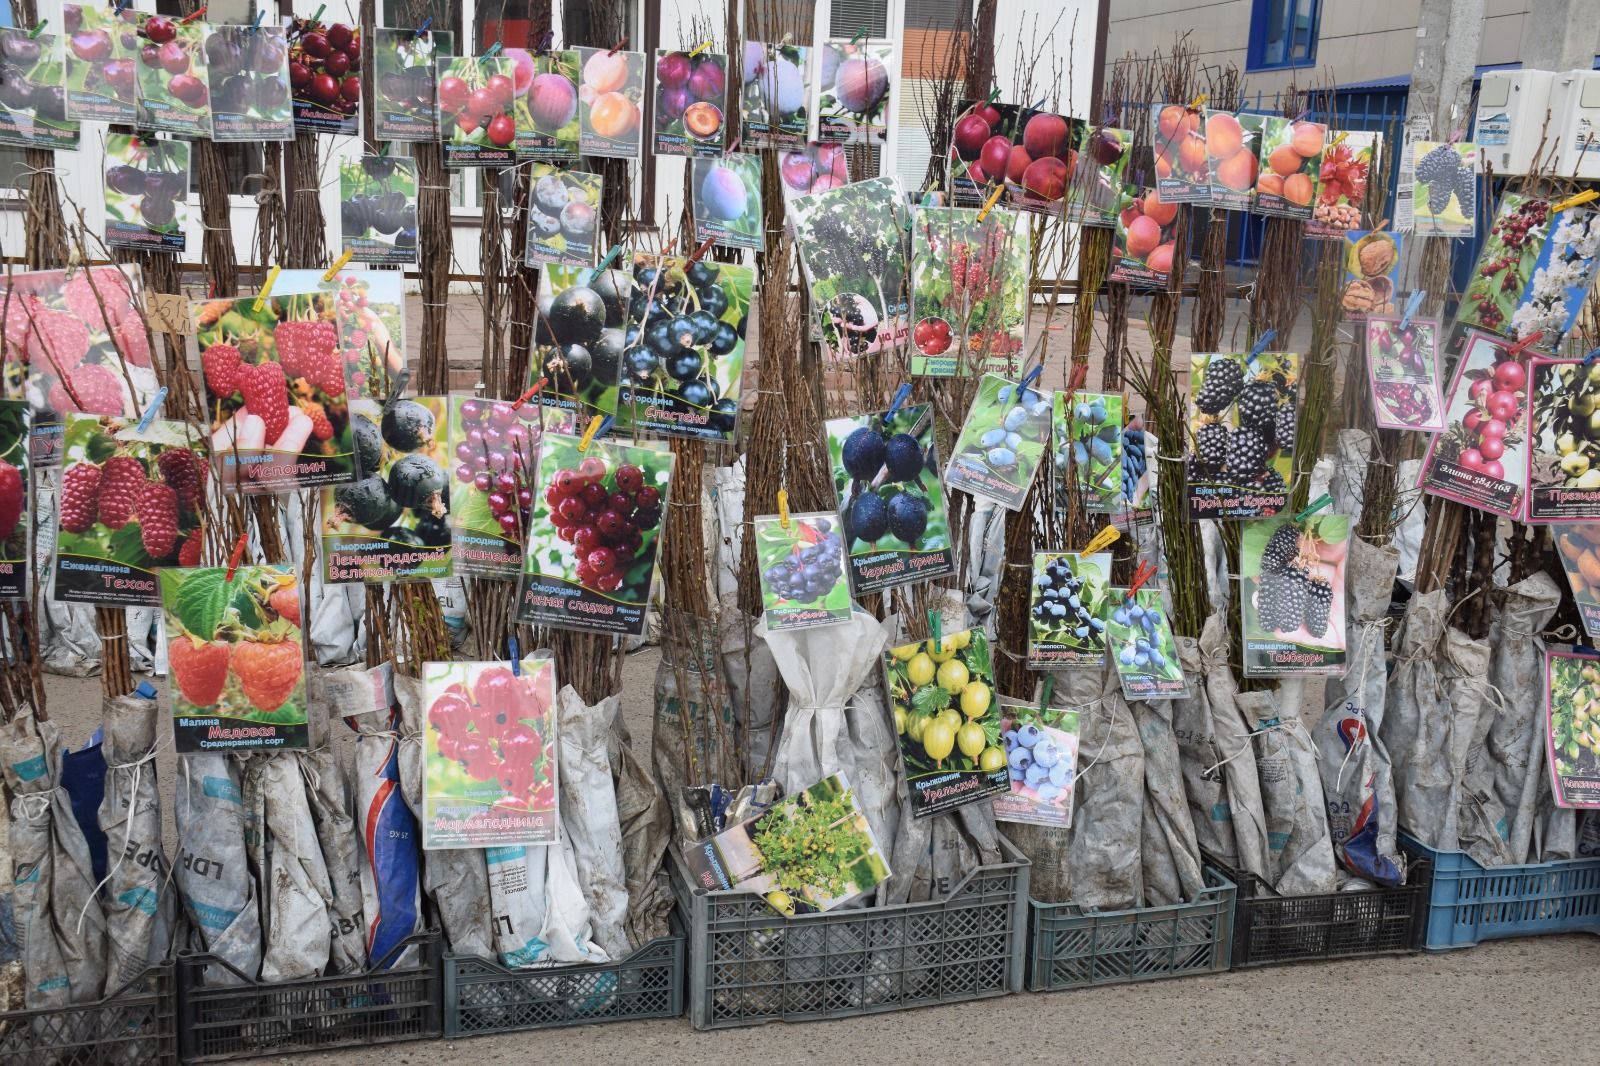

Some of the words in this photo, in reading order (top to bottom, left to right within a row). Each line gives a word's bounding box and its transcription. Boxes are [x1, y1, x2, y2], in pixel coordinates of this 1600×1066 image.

[479, 151, 509, 161] севера
[622, 391, 674, 406] Сородина
[644, 405, 708, 424] Сластена
[247, 461, 326, 478] Исполин
[1439, 464, 1472, 482] Элита
[1473, 475, 1512, 493] 384/168
[1243, 494, 1285, 509] Корона
[333, 541, 389, 552] Смородина
[328, 547, 445, 569] Ленинградский
[852, 551, 899, 568] Крыжовник
[60, 560, 131, 574] Ежемалина
[329, 565, 394, 580] Великан
[396, 567, 427, 577] Средний
[858, 559, 905, 580] Черный
[908, 553, 946, 572] принц
[102, 574, 155, 591] Техас
[530, 581, 582, 597] Смородина
[524, 591, 565, 610] Ранняя
[567, 599, 614, 616] сладкая
[616, 606, 641, 616] Ранний
[623, 614, 640, 623] сорт
[1032, 643, 1067, 651] Жимолость
[1247, 641, 1297, 651] Ежемалина
[1267, 650, 1324, 667] Тайберри
[179, 717, 220, 728] Малина
[207, 725, 276, 739] Медовая
[199, 738, 263, 749] Среднеранний
[264, 737, 285, 748] сорт
[915, 771, 961, 790] Крыжовник
[922, 775, 980, 802] Уральский
[434, 815, 545, 833] Мармеладница
[389, 830, 400, 839] KG
